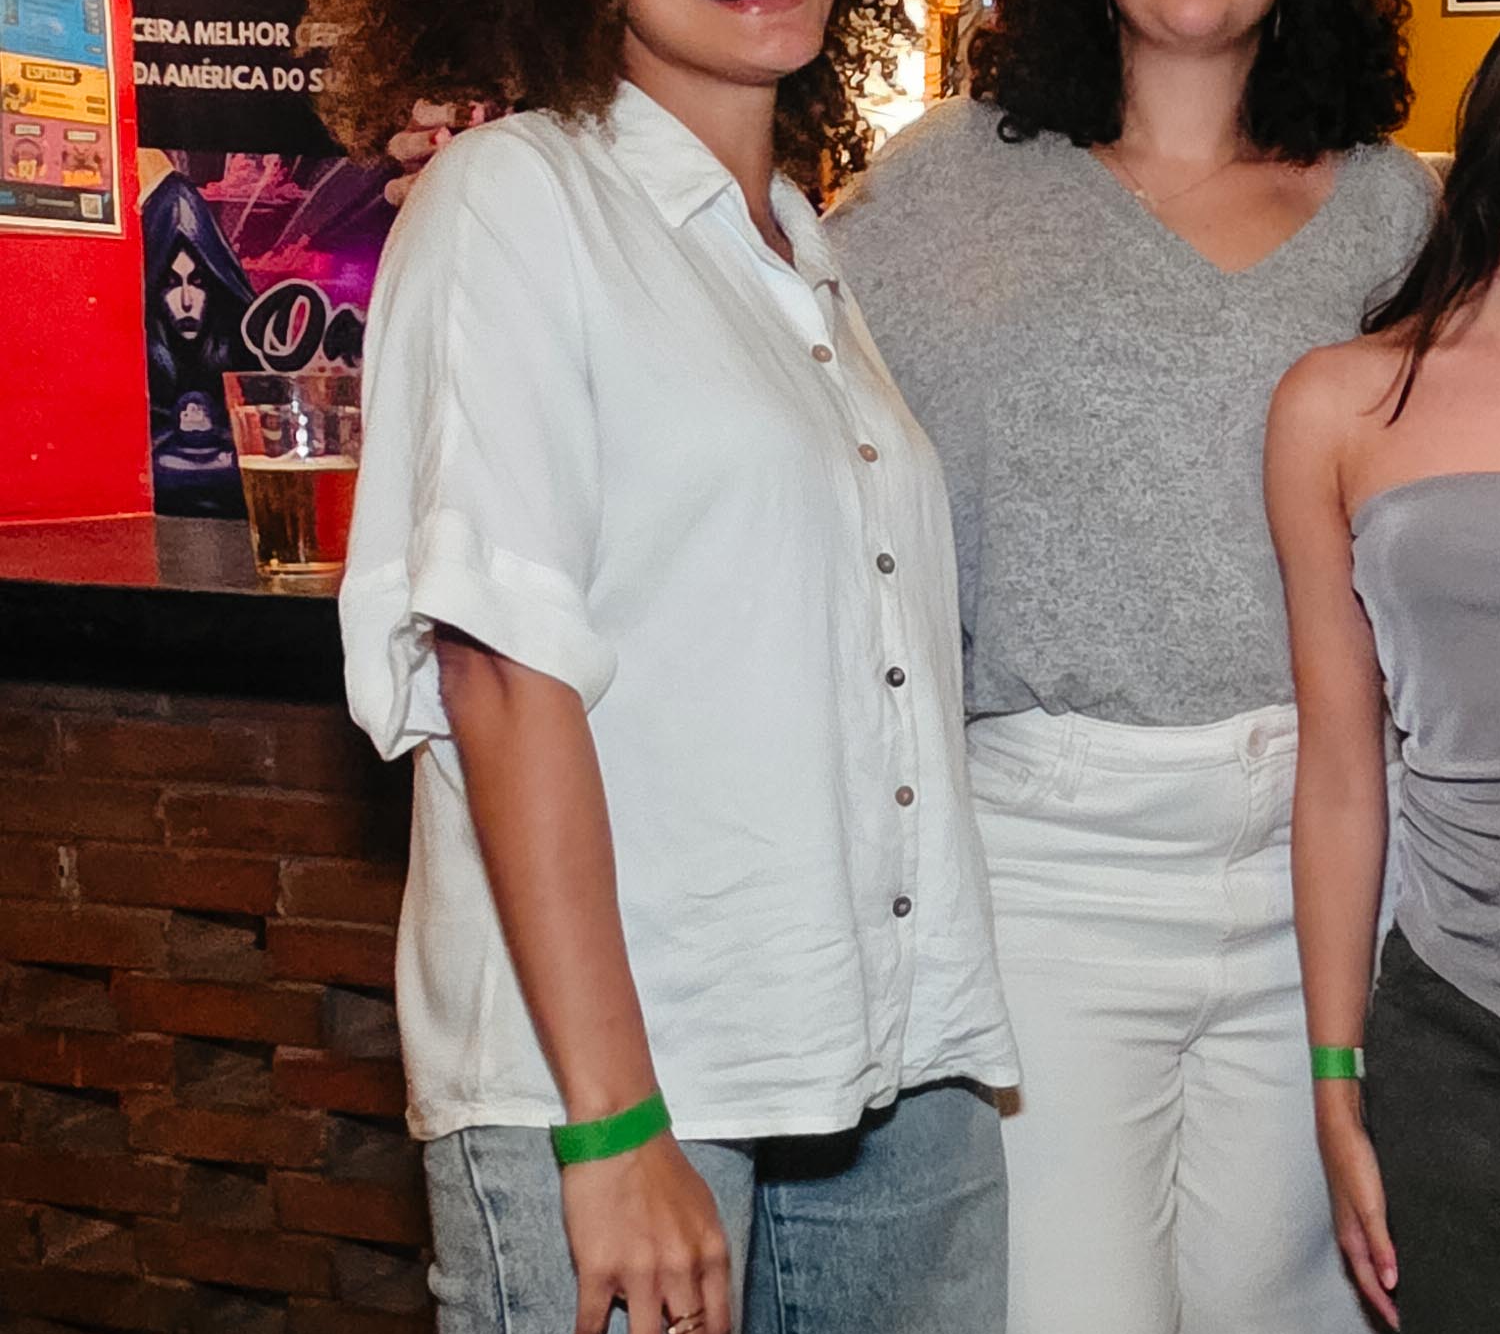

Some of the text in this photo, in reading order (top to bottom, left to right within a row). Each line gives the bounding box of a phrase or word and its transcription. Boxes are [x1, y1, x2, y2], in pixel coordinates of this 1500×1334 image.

[194, 20, 291, 47] MELHOR
[133, 61, 161, 85] DA
[163, 58, 268, 90] AMÉRICA
[272, 67, 305, 92] DO
